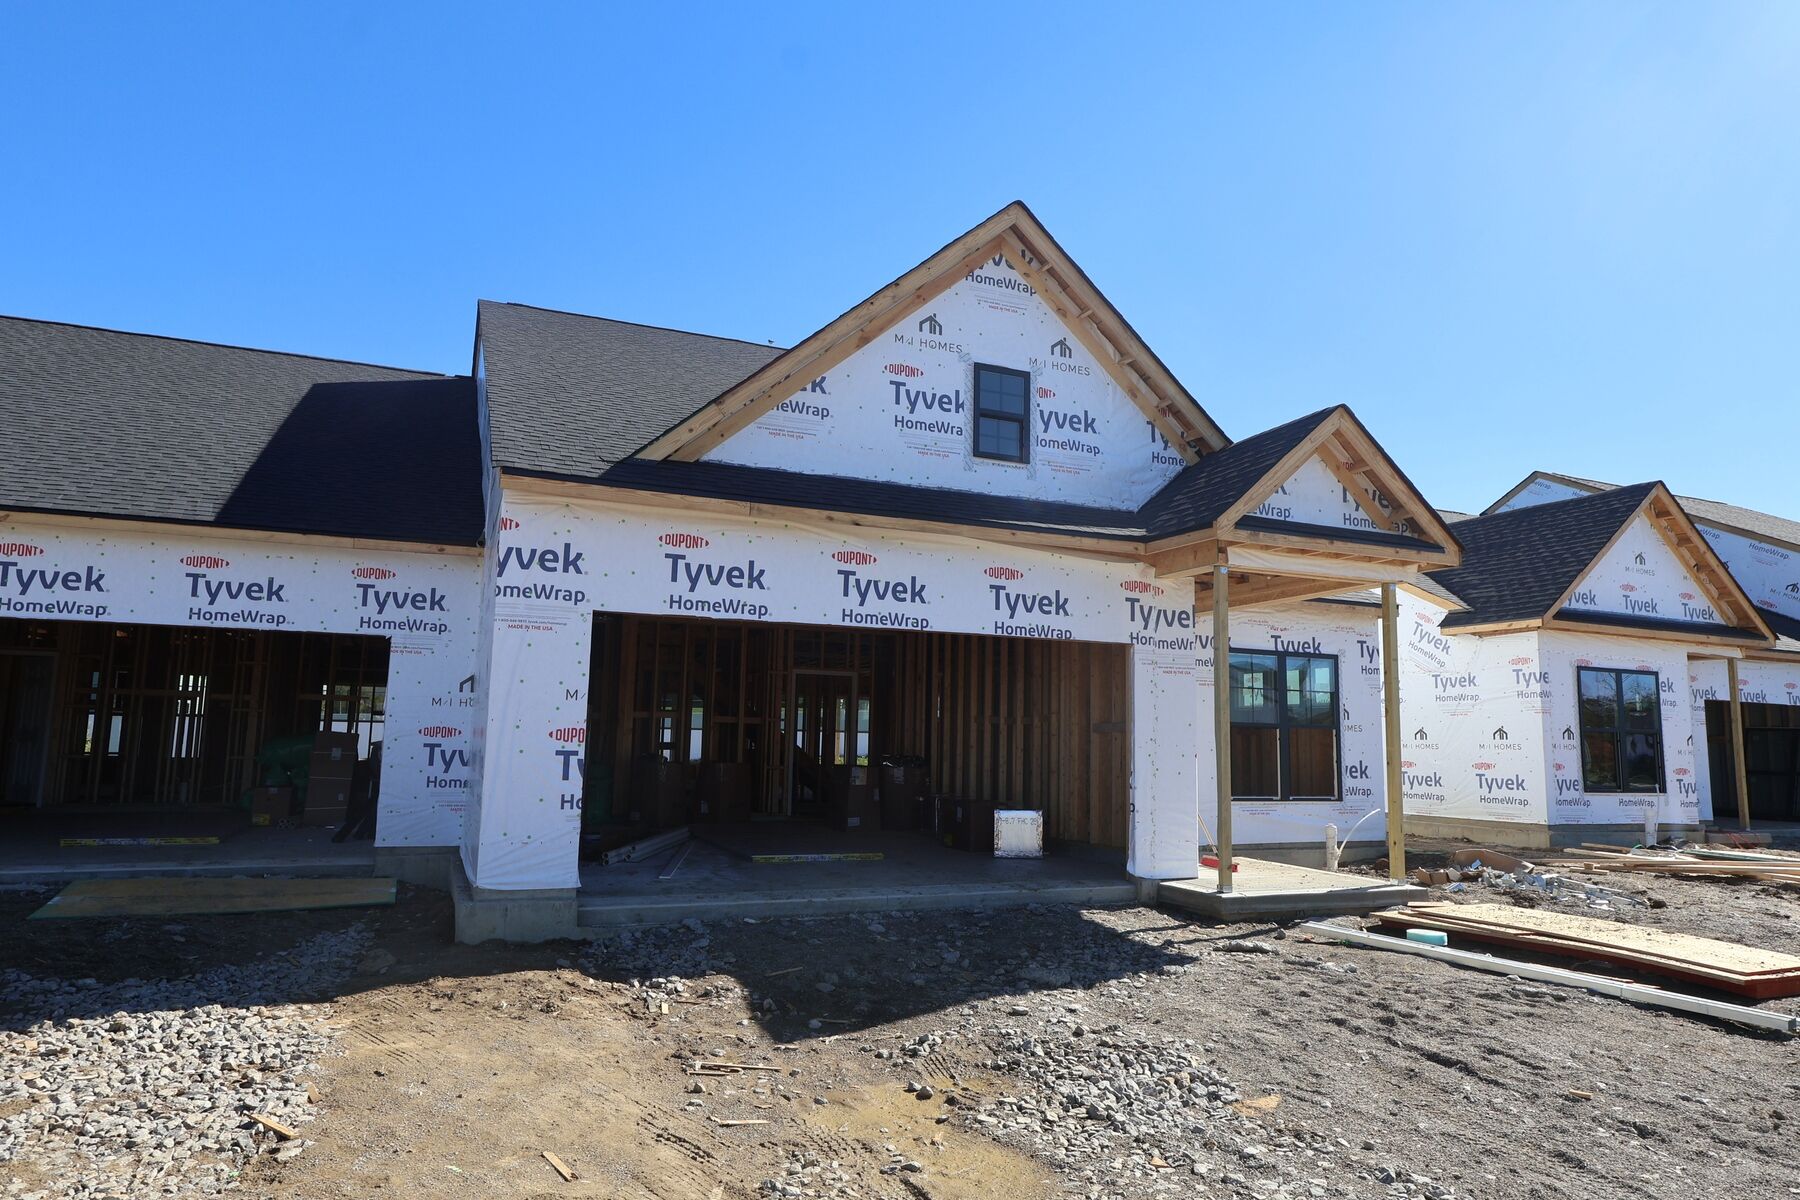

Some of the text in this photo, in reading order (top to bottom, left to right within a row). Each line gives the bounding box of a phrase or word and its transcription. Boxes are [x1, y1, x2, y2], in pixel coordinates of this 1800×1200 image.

[919, 338, 963, 354] HOMES
[888, 364, 920, 378] DUPONT
[1051, 361, 1091, 376] HOMES
[889, 380, 965, 414] Tyvek
[894, 414, 963, 436] HomeWra
[1037, 403, 1097, 434] yvek
[1152, 451, 1185, 466] Home
[0, 543, 38, 557] UPONT
[664, 533, 704, 549] DUPONT
[497, 542, 583, 578] yvek
[837, 551, 873, 565] DUPONT
[1748, 542, 1790, 560] HomeWrap
[185, 556, 224, 569] DUPONT
[0, 561, 105, 596] Tyvek
[357, 567, 392, 580] DUPONT
[664, 553, 766, 592] Tyvek
[988, 567, 1020, 580] DUPONT
[185, 572, 285, 605] Tyvek
[495, 583, 586, 606] omeWrap
[837, 569, 926, 607] Tyvek
[1568, 589, 1597, 606] yvek
[0, 598, 107, 618] HomeWrap
[356, 583, 446, 615] Tyvek
[669, 594, 769, 619] HomeWrap
[989, 584, 1070, 619] Tyvek
[1622, 594, 1658, 614] Tyvek
[188, 607, 286, 626] HomeWrap
[841, 608, 930, 630] HomeWrap
[1682, 603, 1715, 621] Tyvek
[359, 616, 448, 635] HomeWrap
[994, 621, 1072, 639] HomeWrap
[1412, 621, 1452, 655] Tyvek
[1407, 640, 1446, 668] HomeWrap
[1431, 672, 1477, 693] Tyvek
[1512, 668, 1549, 688] Tyve
[1435, 693, 1480, 702] HomeWrap
[1516, 690, 1552, 699] HomeW
[1691, 686, 1718, 704] yvek
[423, 726, 458, 738] DUPONT
[555, 727, 585, 743] DUPO
[423, 743, 470, 774] Tyv
[1401, 771, 1443, 790] Tyvek
[1475, 773, 1526, 794] Tyvek
[1556, 777, 1580, 796] yve
[1345, 786, 1372, 798] eWrap
[1403, 791, 1445, 802] HomeWrap
[1479, 795, 1529, 807] HomeWrap
